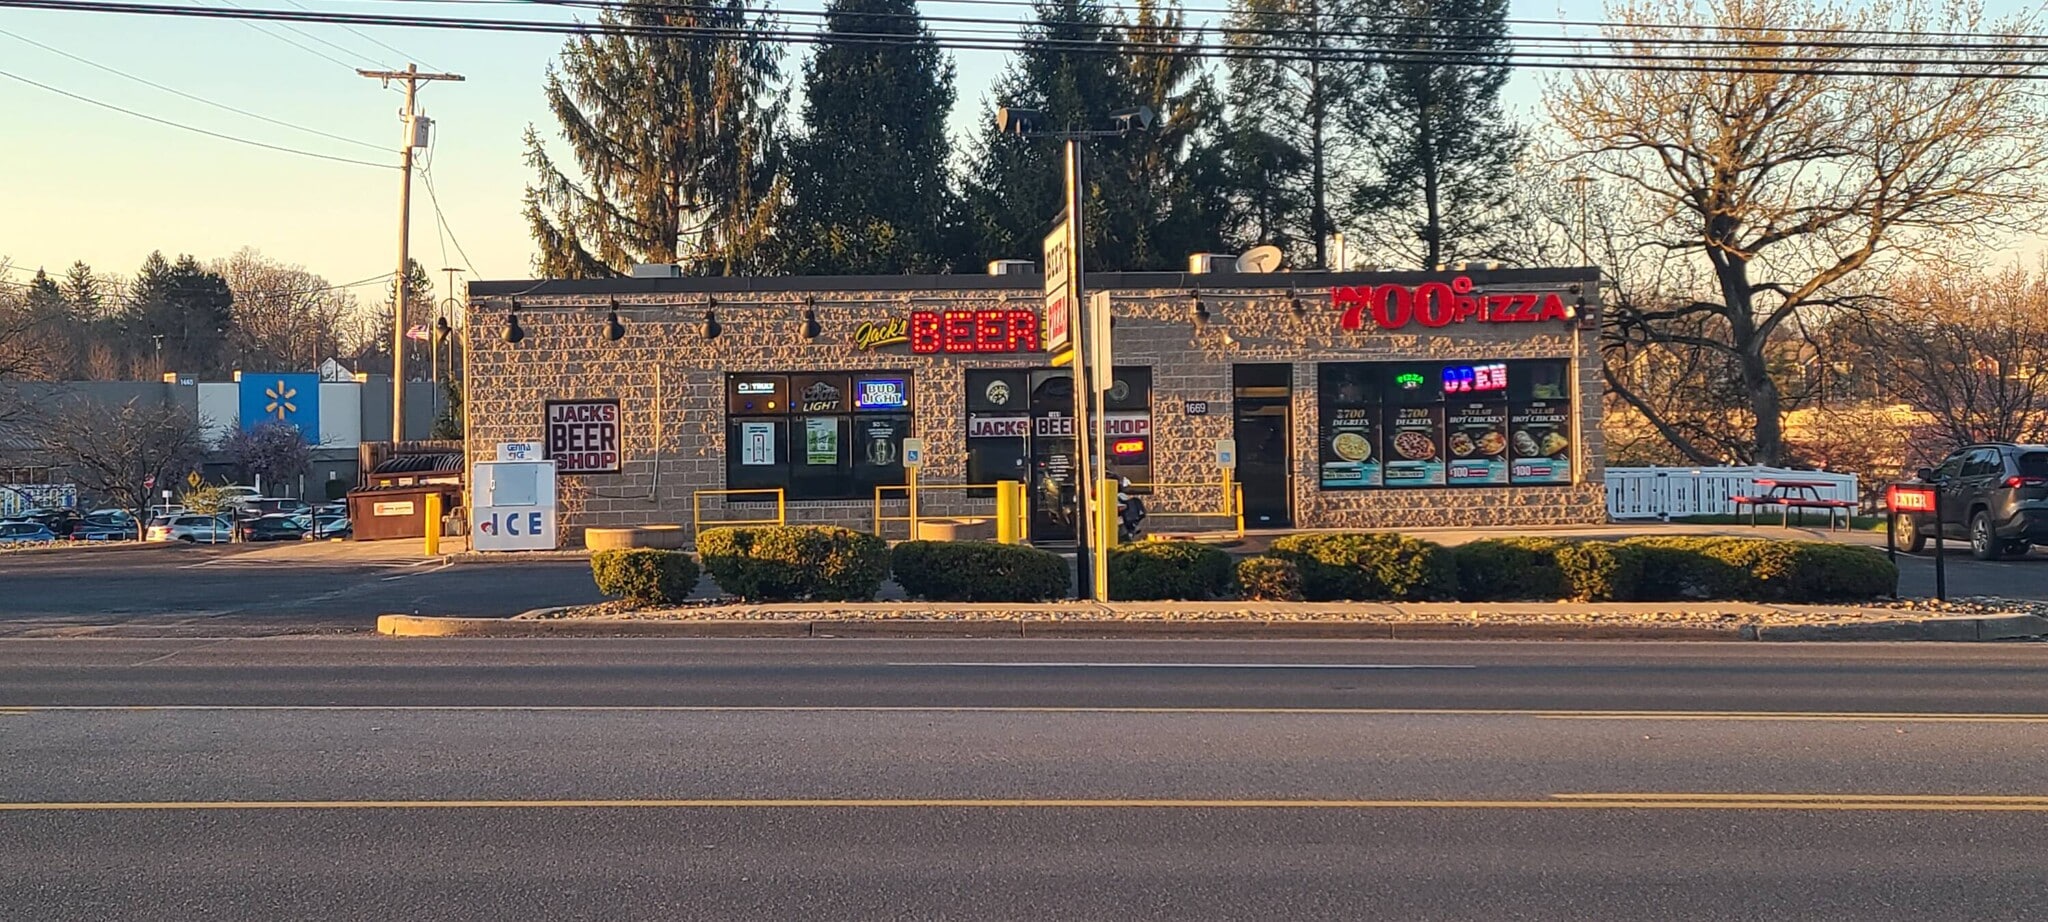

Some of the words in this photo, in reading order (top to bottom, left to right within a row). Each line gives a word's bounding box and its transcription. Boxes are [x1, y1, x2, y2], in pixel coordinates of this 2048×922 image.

[1455, 294, 1569, 323] PIZZA
[855, 316, 907, 350] Jack's
[911, 310, 1038, 353] BEER
[1442, 364, 1507, 393] OPEN
[866, 383, 896, 394] BUD
[803, 400, 840, 412] LIGHT
[861, 393, 902, 404] LIGHT
[552, 405, 615, 422] JACKS
[1186, 402, 1206, 414] 1669
[970, 421, 1029, 435] JACKS
[552, 423, 616, 452] BEER
[552, 452, 617, 470] SHOP
[1894, 493, 1927, 508] ENTER
[491, 512, 542, 536] ICE
